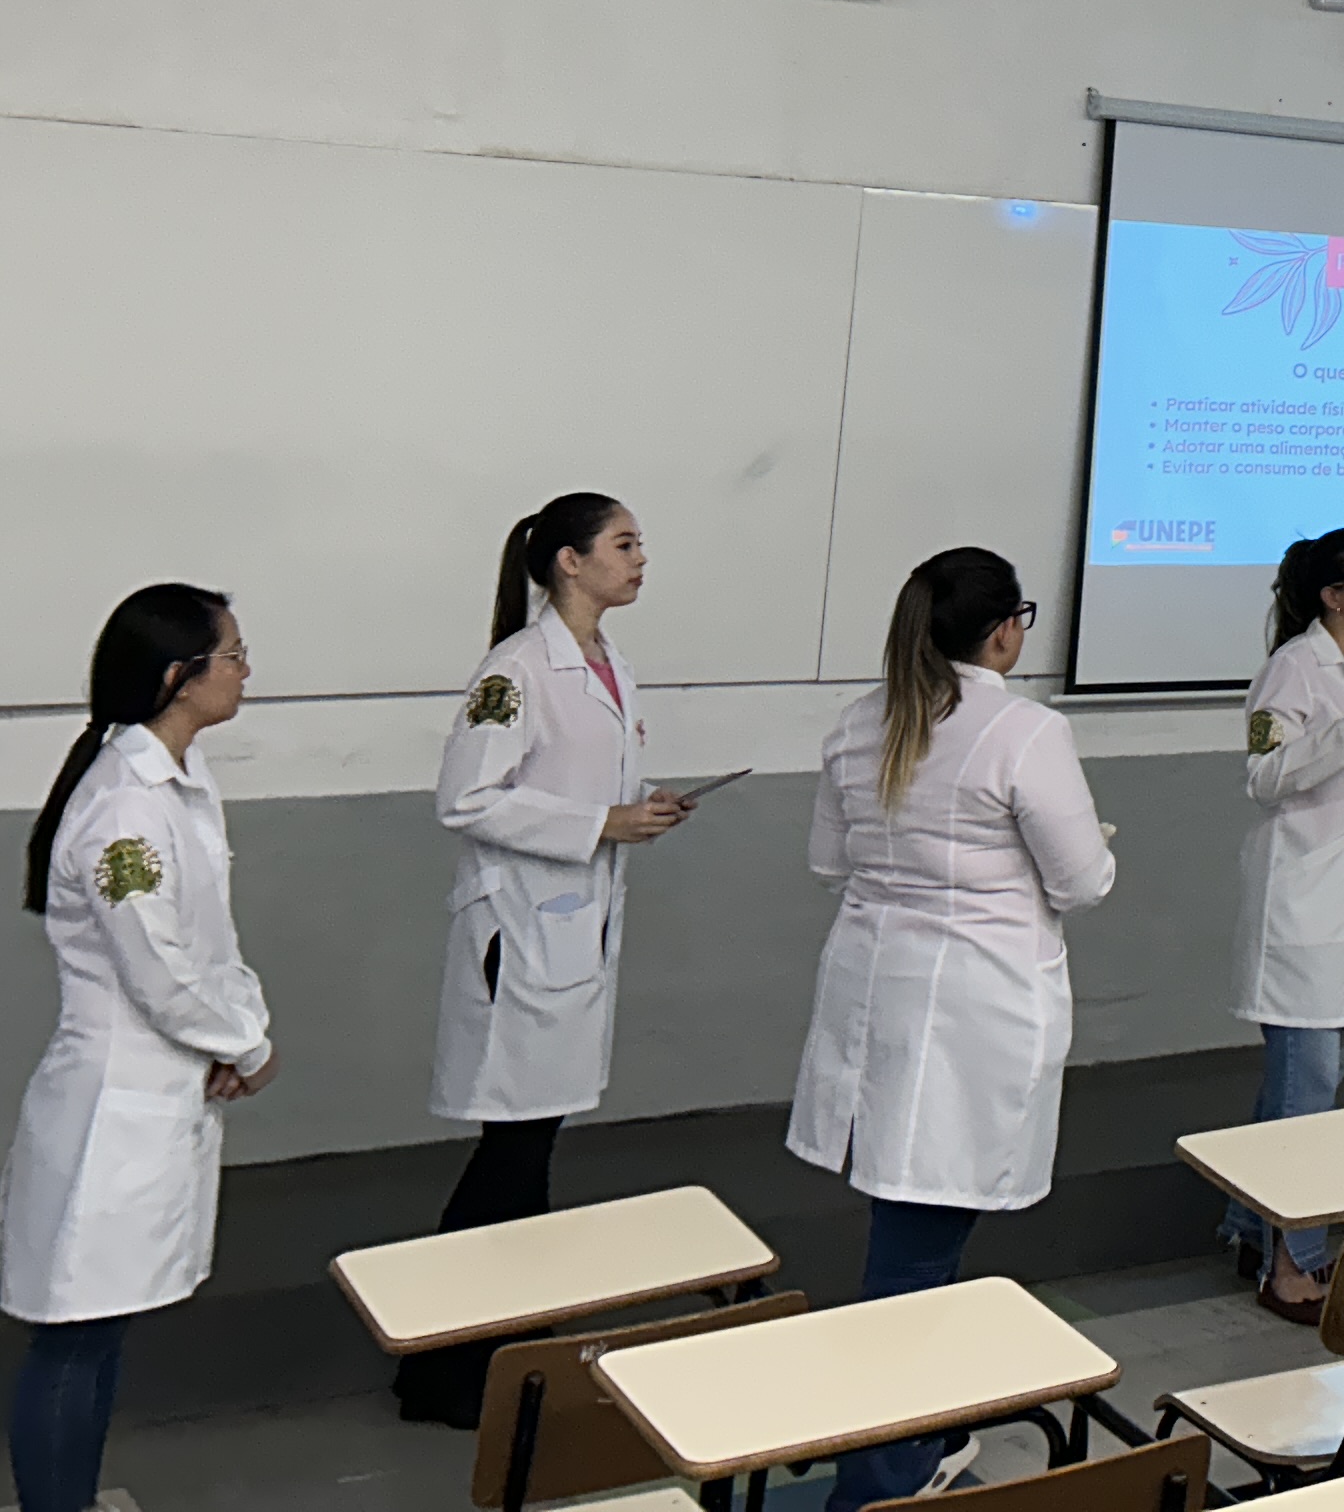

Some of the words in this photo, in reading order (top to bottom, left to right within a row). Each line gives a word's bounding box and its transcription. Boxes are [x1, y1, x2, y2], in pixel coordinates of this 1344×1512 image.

[1293, 363, 1308, 379] O
[1165, 396, 1236, 413] Praticar
[1240, 399, 1317, 416] atividade
[1164, 418, 1228, 433] Manter
[1231, 423, 1243, 434] o
[1247, 423, 1285, 437] peso
[1162, 439, 1225, 454] Adotar
[1229, 442, 1265, 454] uma
[1162, 459, 1214, 474] Evitar
[1218, 463, 1230, 474] o
[1234, 463, 1307, 476] consumo
[1311, 462, 1332, 477] de
